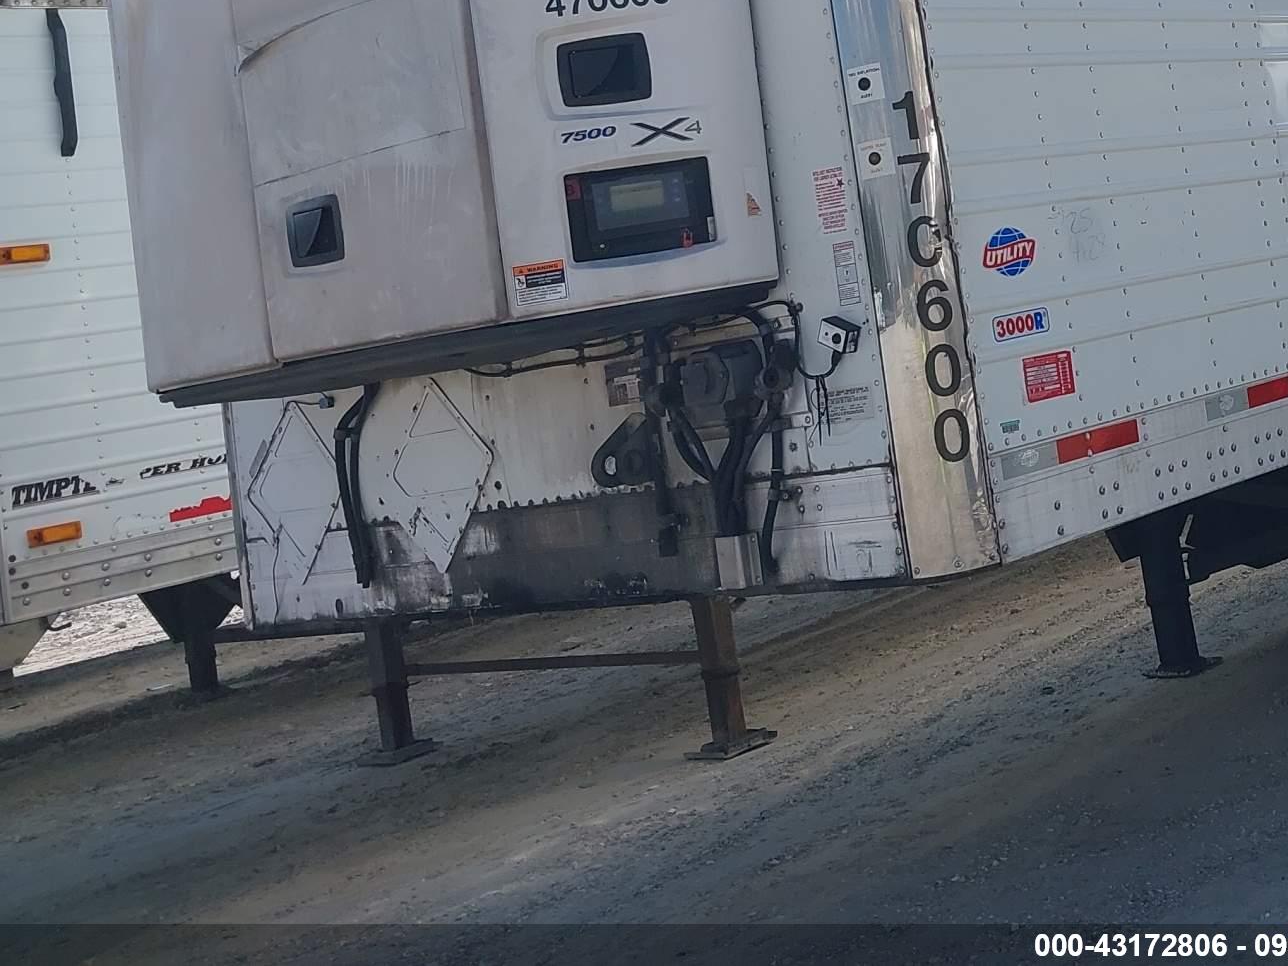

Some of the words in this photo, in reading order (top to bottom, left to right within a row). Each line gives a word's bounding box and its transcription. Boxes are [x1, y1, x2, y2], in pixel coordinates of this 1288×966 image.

[561, 126, 616, 144] 7500
[986, 240, 1033, 266] UTILITY
[996, 311, 1045, 338] 3000R
